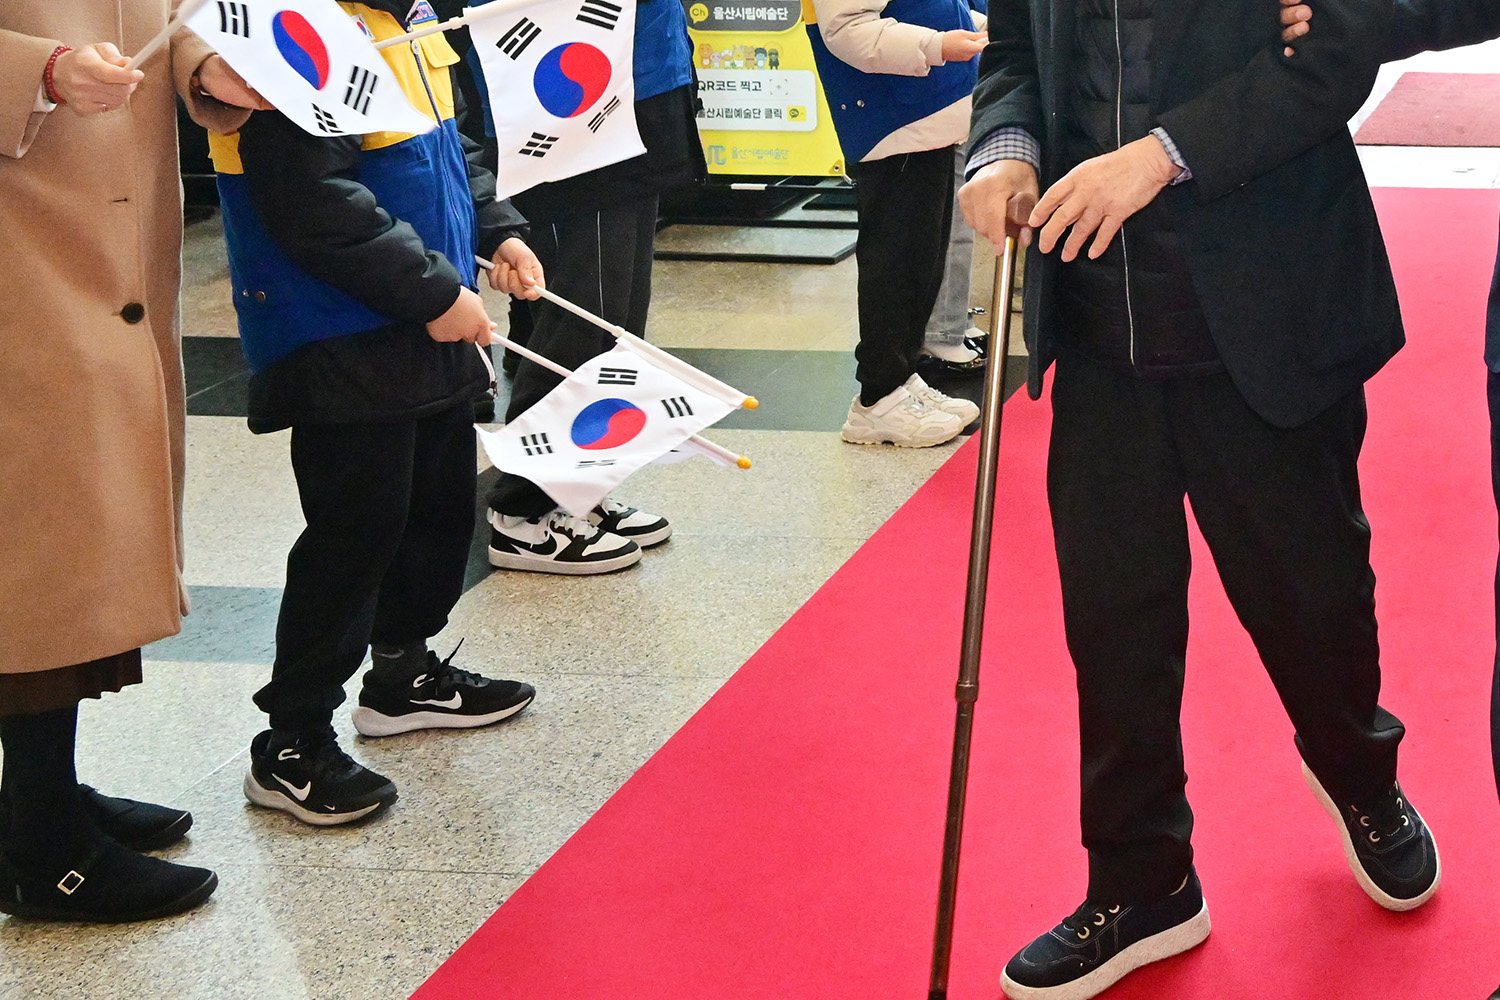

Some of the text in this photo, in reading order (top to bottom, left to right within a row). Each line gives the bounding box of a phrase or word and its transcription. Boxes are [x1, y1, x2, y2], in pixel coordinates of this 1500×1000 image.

[692, 8, 705, 16] Ch
[713, 7, 788, 21] 울산시립예술단
[741, 80, 762, 92] 찍고
[764, 108, 783, 120] 클릭
